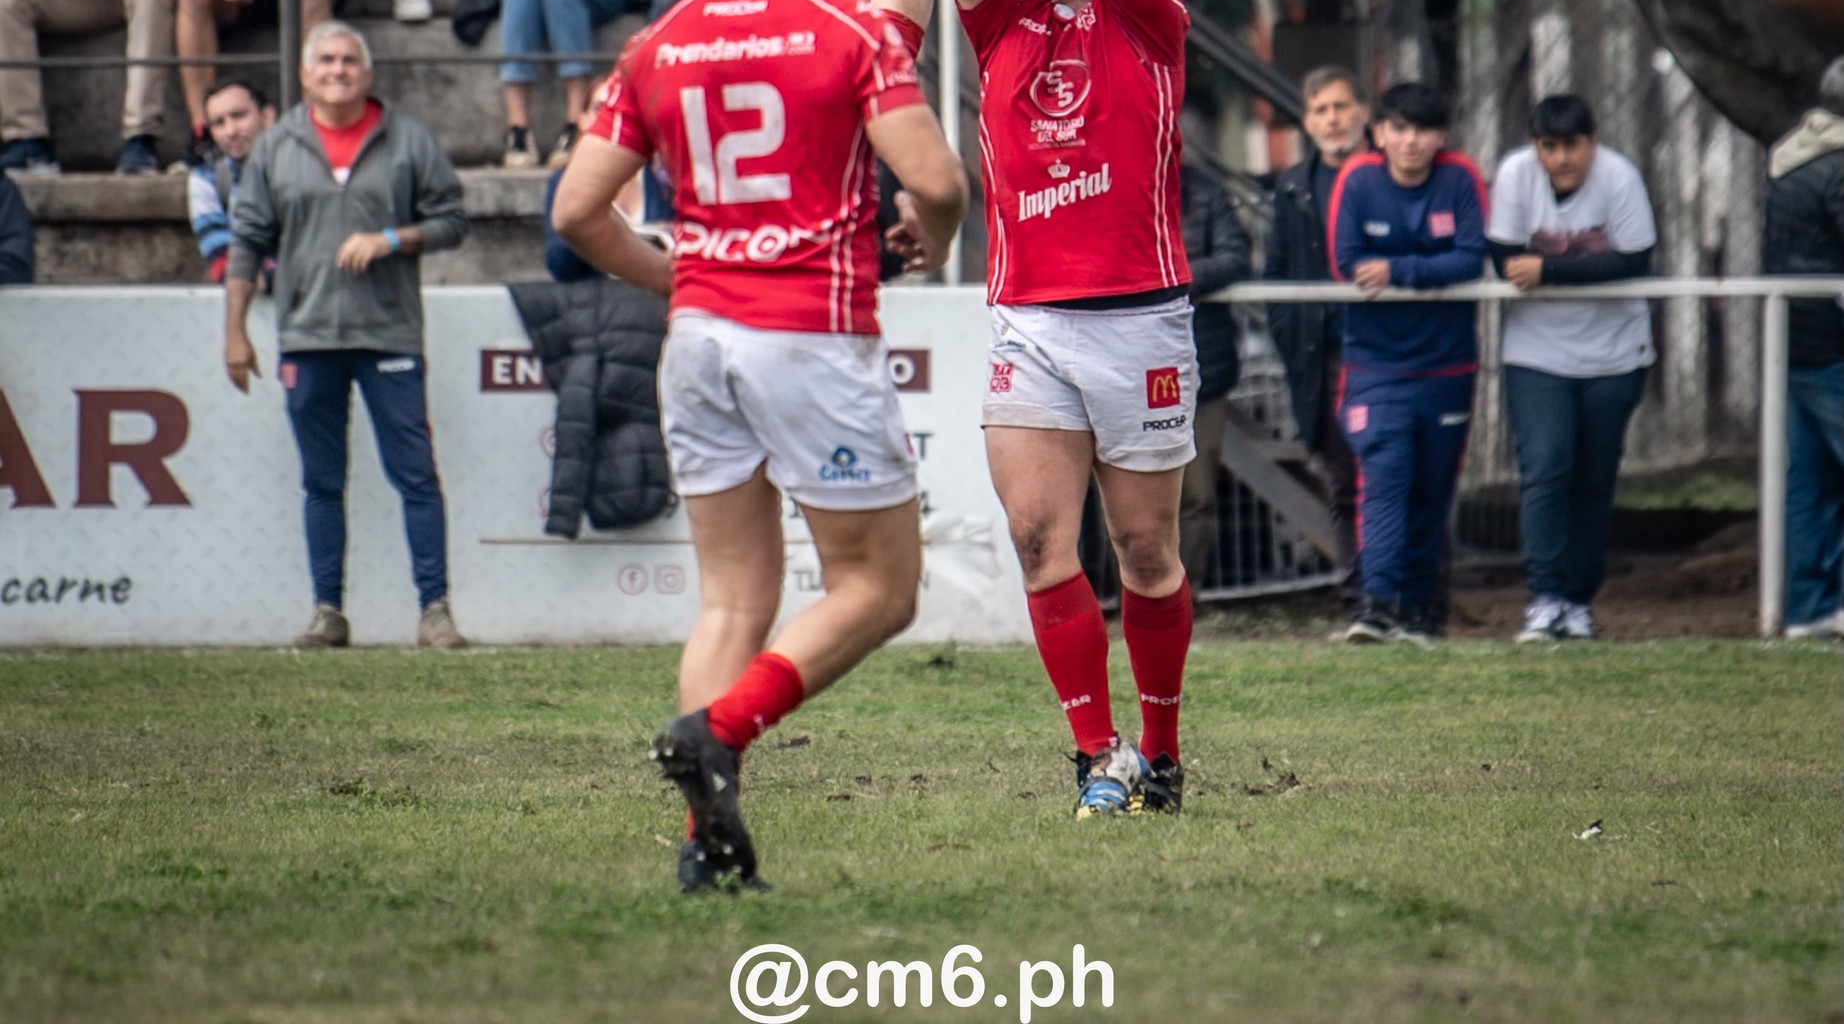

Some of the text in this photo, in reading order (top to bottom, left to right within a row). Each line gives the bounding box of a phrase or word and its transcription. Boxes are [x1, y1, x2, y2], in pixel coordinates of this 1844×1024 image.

[655, 34, 784, 70] Prendarios
[680, 81, 792, 206] 12
[1017, 162, 1112, 223] Imperial
[1142, 414, 1188, 432] PROCER
[0, 576, 133, 605] carne
